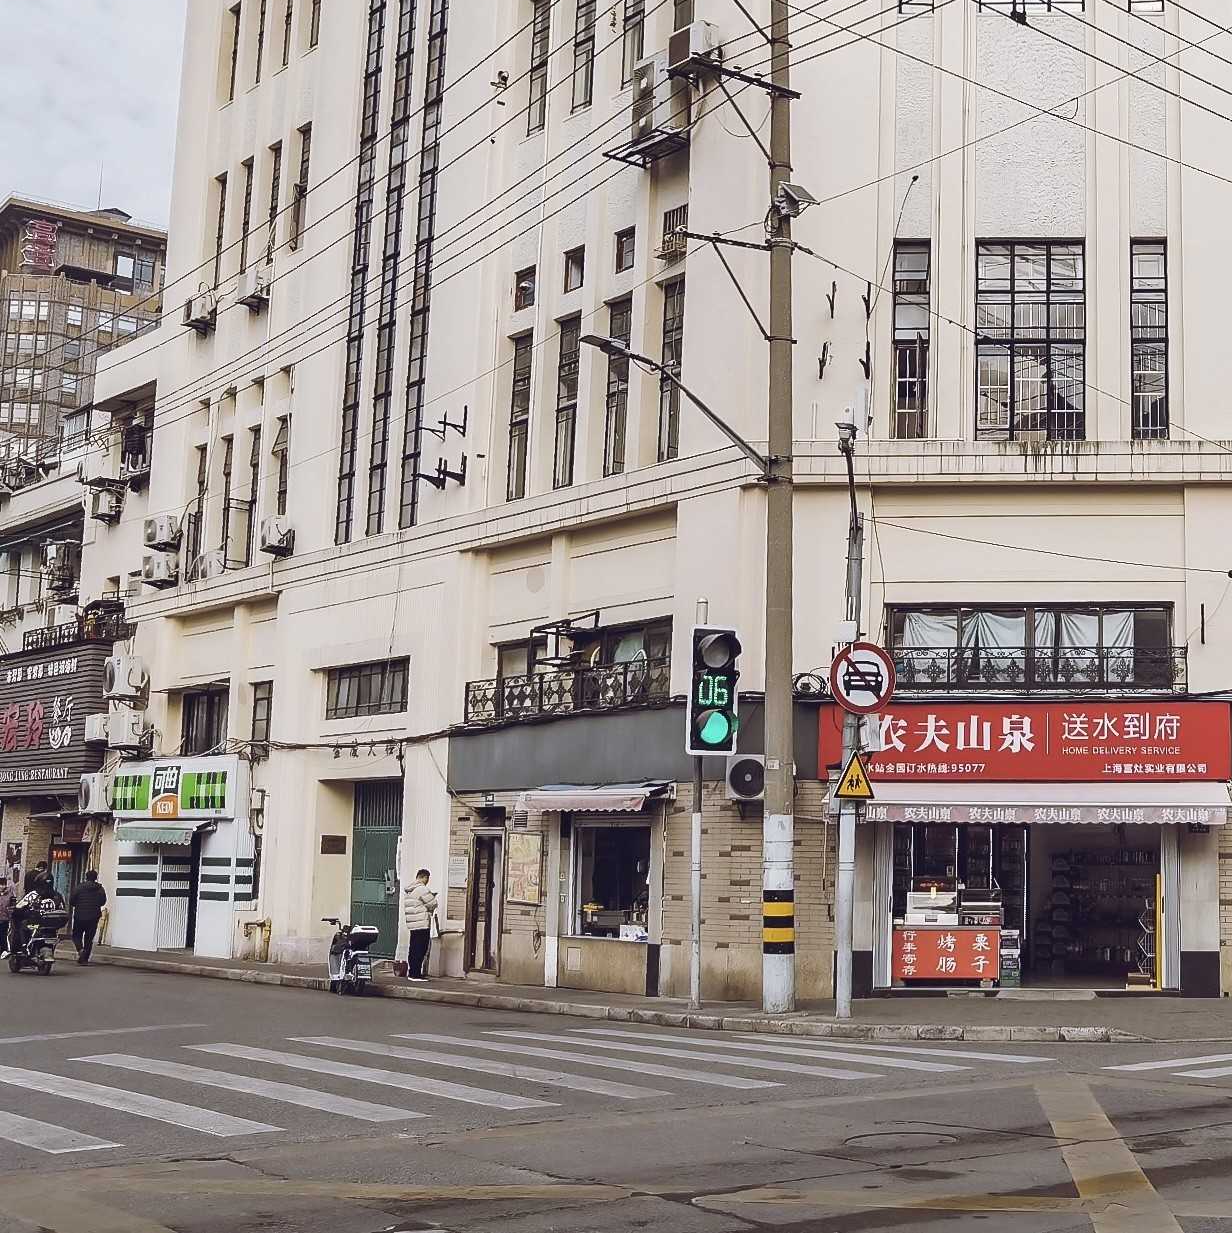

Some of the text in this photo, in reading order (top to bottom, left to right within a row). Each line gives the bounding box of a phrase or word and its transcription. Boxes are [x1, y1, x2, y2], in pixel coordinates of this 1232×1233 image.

[698, 674, 729, 706] 06
[878, 714, 1036, 753] 农夫山泉
[1061, 712, 1181, 741] 送水到府
[1062, 746, 1181, 755] HOME DELIVERY SERVICE
[30, 767, 69, 780] RESTAURANT
[156, 801, 174, 814] KEDI
[866, 805, 889, 820] 山泉
[936, 932, 957, 973] 烤肠
[971, 933, 992, 973] 栗子
